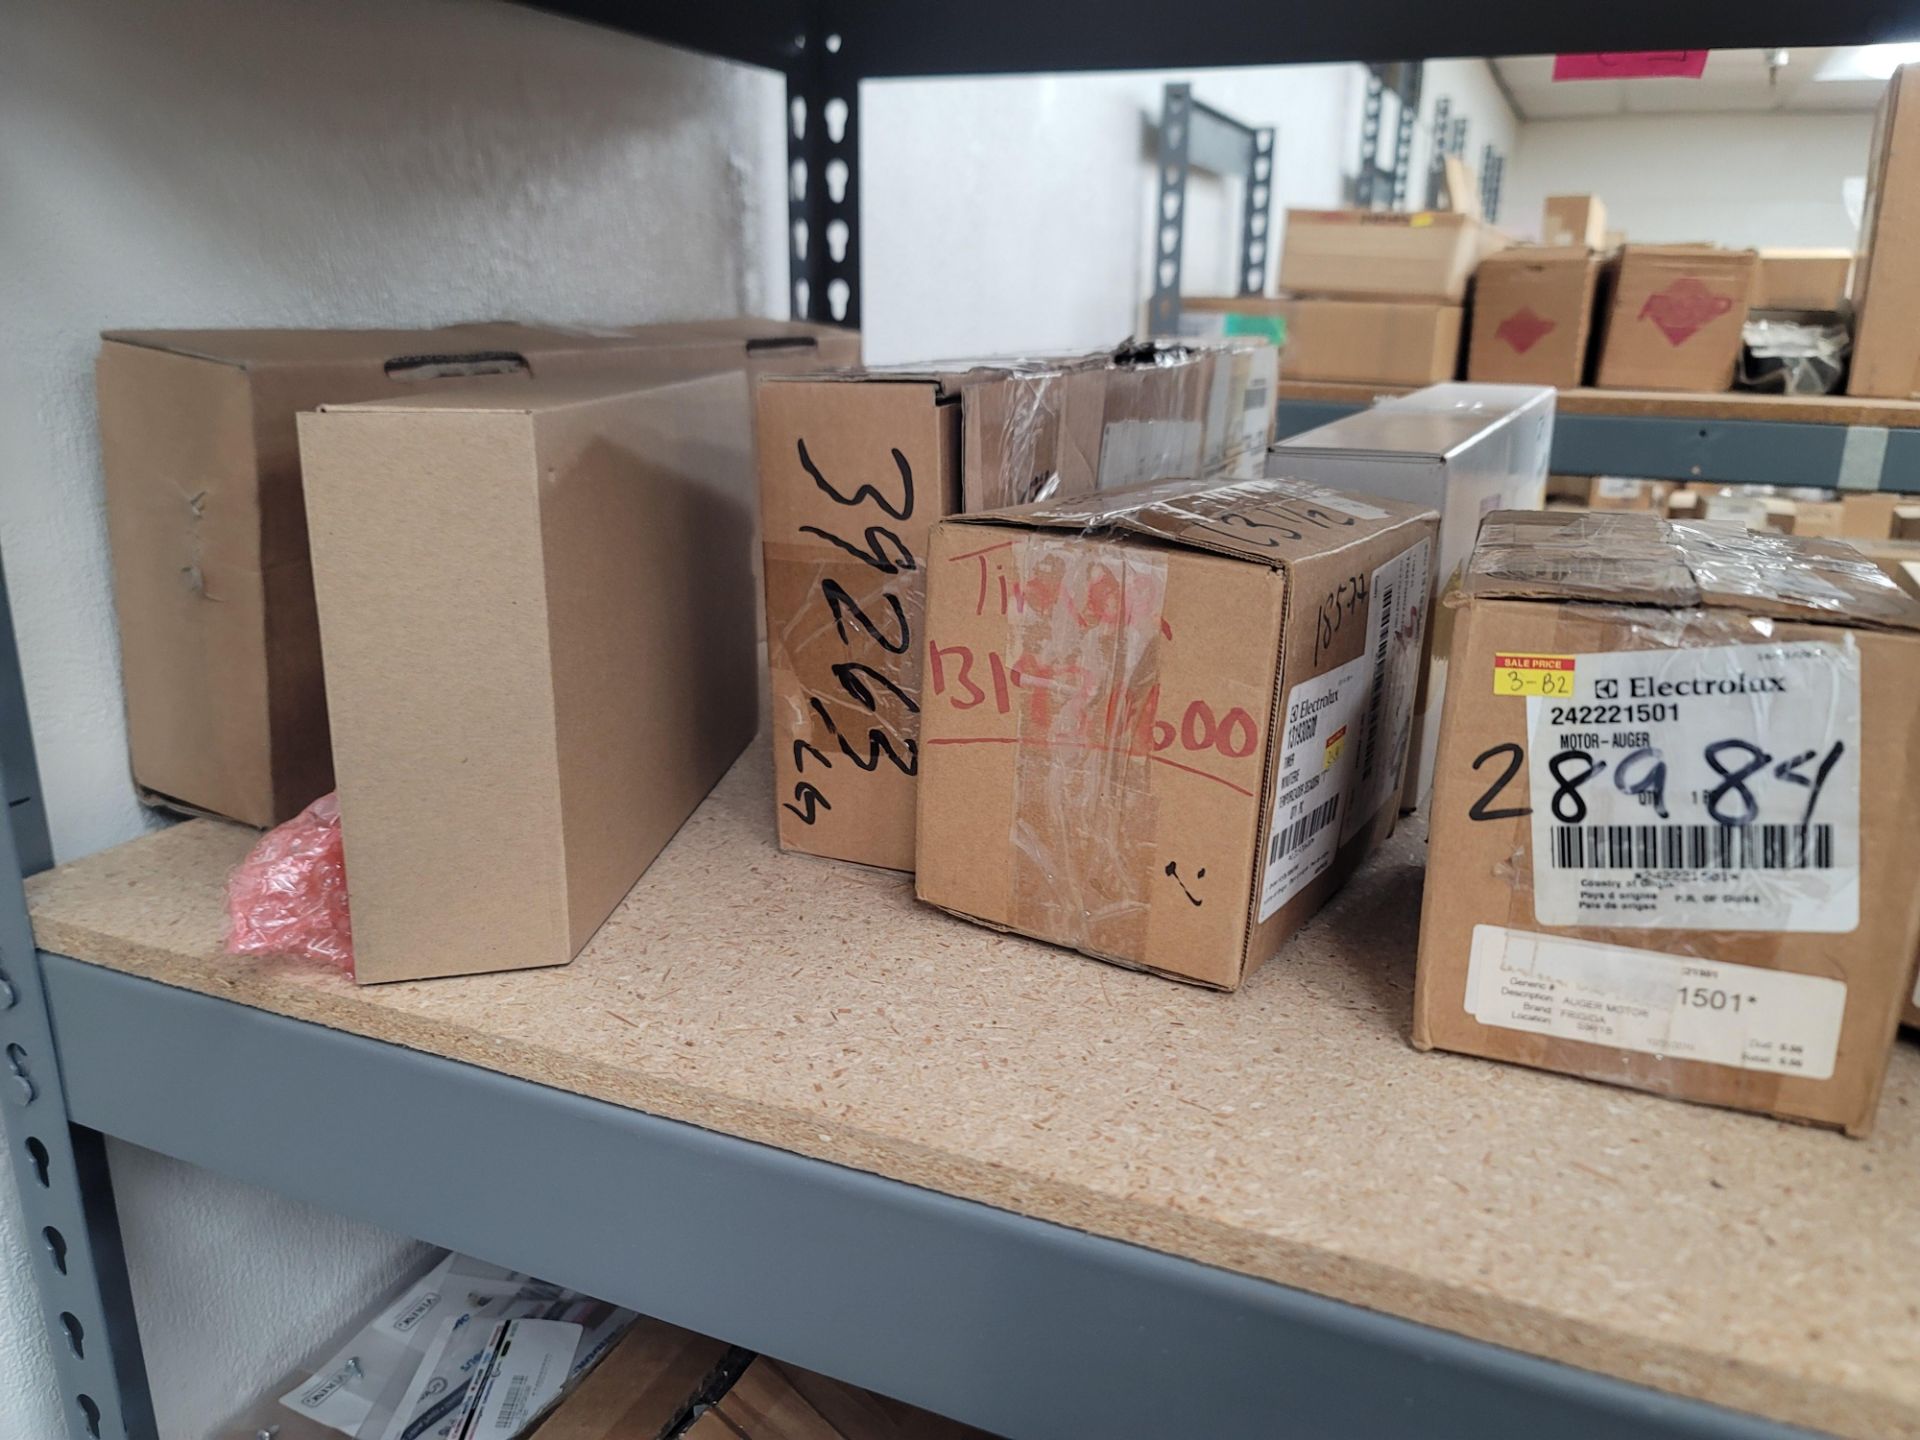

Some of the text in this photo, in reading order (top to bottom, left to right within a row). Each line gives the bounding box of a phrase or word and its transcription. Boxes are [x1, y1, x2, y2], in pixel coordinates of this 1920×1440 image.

[1504, 658, 1562, 669] SALE PRICE
[1629, 672, 1787, 698] Electrolux
[1300, 688, 1340, 719] Electrolux
[1551, 703, 1680, 726] 242221501
